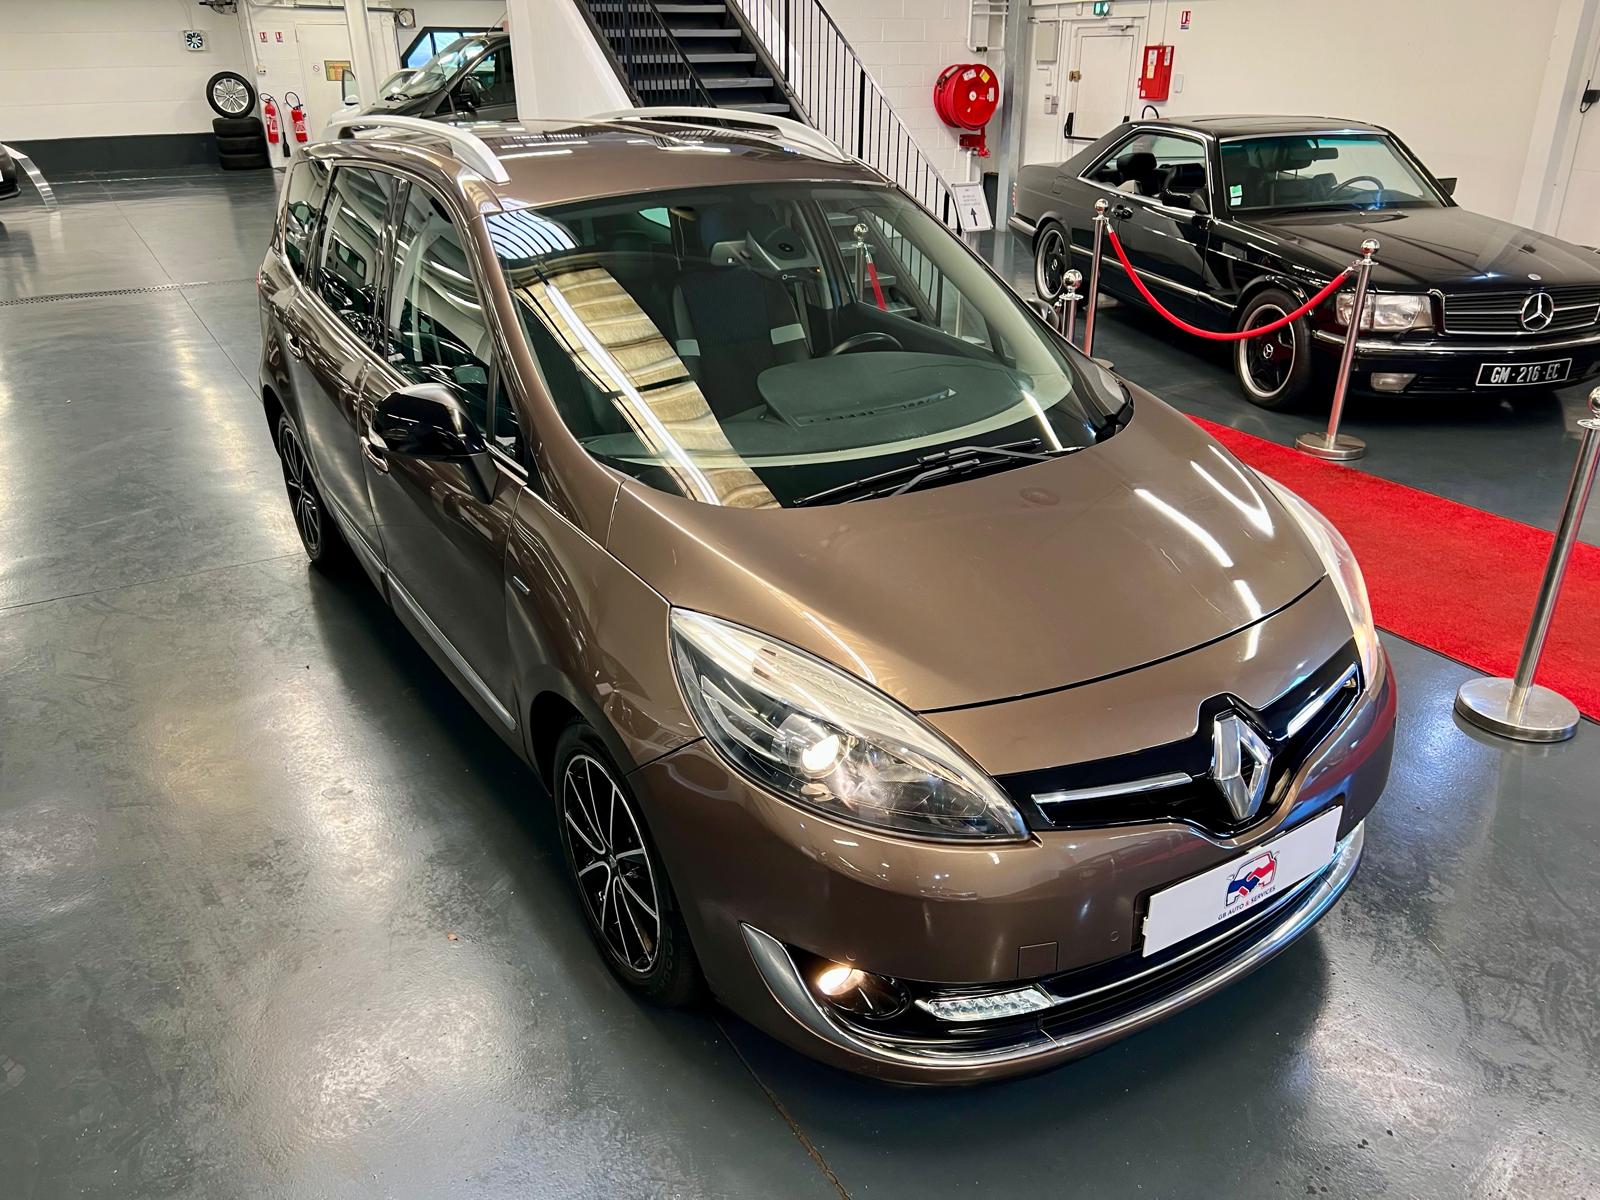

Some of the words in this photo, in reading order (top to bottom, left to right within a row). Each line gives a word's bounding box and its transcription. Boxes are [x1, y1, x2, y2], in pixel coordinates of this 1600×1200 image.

[1218, 912, 1226, 920] GB
[1228, 904, 1244, 916] AUTO
[1251, 886, 1276, 903] SERVICES
